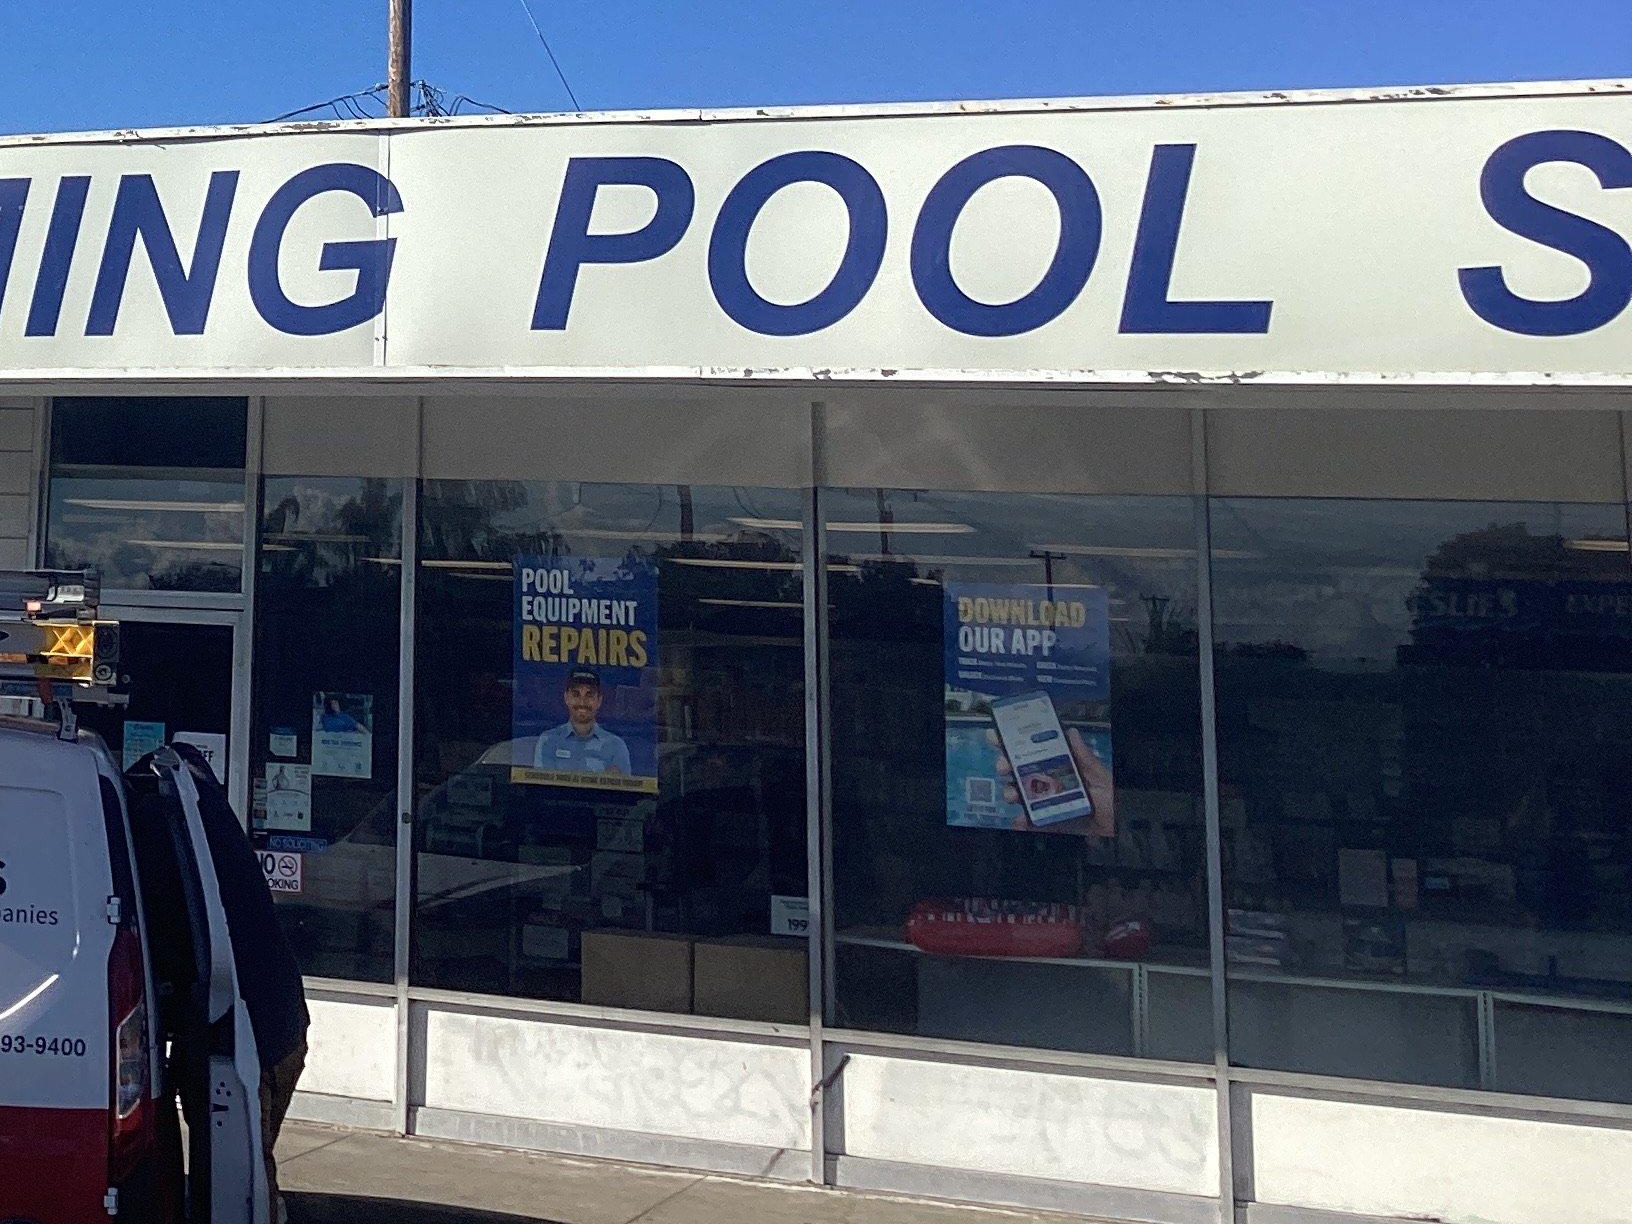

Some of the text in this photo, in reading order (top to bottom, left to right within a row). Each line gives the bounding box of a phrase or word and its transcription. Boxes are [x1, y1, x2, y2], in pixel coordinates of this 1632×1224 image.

[529, 143, 1274, 338] POOL
[521, 567, 574, 595] POOL
[521, 595, 638, 626] EQUIPMENT
[957, 596, 1086, 628] DOWNLOAD
[522, 624, 648, 668] REPAIRS
[958, 625, 1057, 657] OUR APP
[267, 877, 299, 891] OKING
